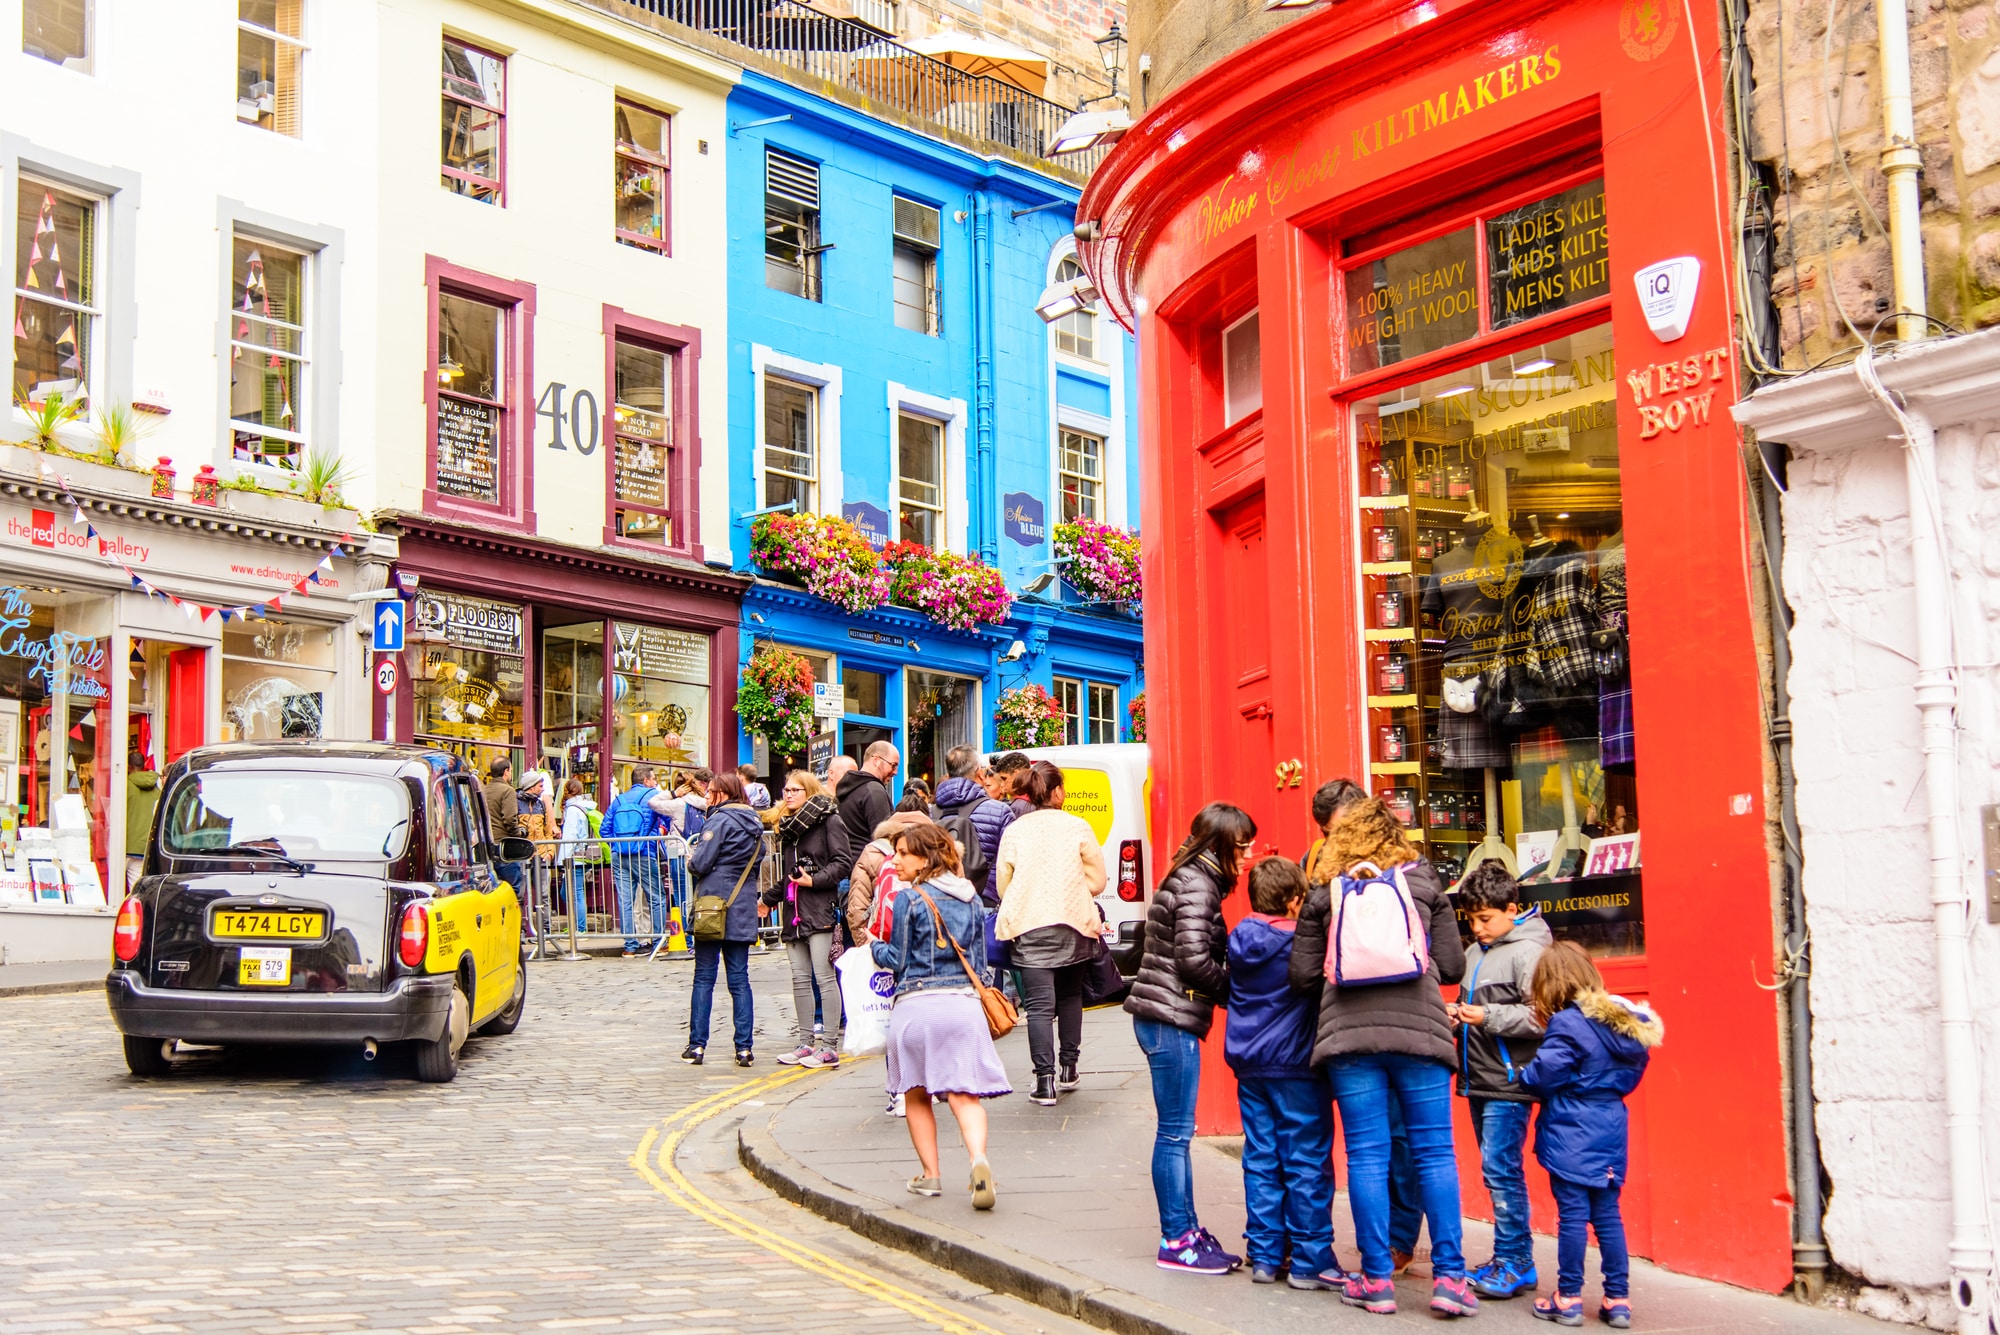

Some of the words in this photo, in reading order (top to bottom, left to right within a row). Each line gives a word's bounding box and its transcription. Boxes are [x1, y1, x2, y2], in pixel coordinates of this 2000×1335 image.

[1196, 174, 1258, 247] Victor
[1266, 141, 1341, 216] Scott
[1351, 45, 1562, 162] KILTMAKERS
[1498, 208, 1565, 253] LADIES
[1570, 193, 1606, 228] KILT
[1511, 244, 1555, 280] KIDS
[1561, 224, 1609, 263] KILTS
[1357, 283, 1404, 318] 100%
[1408, 260, 1466, 300] HEAVY
[1506, 274, 1564, 314] MENS
[1570, 257, 1609, 294] KILT
[1650, 273, 1670, 298] iQ
[1348, 307, 1417, 349] WEIGHT
[1422, 287, 1479, 325] WOOL
[1626, 347, 1728, 406] WEST
[443, 400, 460, 412] WE
[463, 407, 487, 419] HOPE
[536, 381, 599, 456] 40
[1638, 387, 1716, 439] BOW
[444, 421, 459, 429] with
[473, 419, 494, 429] chosen
[622, 425, 652, 436] AFRAID
[630, 417, 647, 427] NOT
[650, 422, 661, 430] BE
[1362, 401, 1437, 450] MADE
[1444, 393, 1471, 428] IN
[439, 428, 475, 441] intelligence
[477, 436, 490, 445] that
[455, 441, 473, 450] spark
[1388, 444, 1449, 481] MADE
[1455, 433, 1486, 465] TO
[1492, 400, 1606, 455] MEASURE
[438, 471, 471, 482] Aesthetic
[472, 479, 491, 487] which
[450, 482, 472, 491] appeal
[8, 517, 31, 538] the
[33, 523, 54, 542] red
[57, 526, 92, 548] door
[99, 536, 149, 562] allery
[1020, 521, 1045, 539] BLEUE
[0, 586, 34, 617] The
[448, 603, 514, 631] FLOORS!
[1440, 598, 1504, 640] Victor
[1513, 595, 1569, 632] Scott
[448, 626, 467, 636] Please
[468, 628, 482, 637] make
[483, 631, 495, 639] free
[643, 635, 667, 644] Replica
[849, 630, 874, 639] RESTAURANT
[1472, 630, 1533, 651] KILTMAKERS
[0, 614, 46, 679] Crag
[427, 651, 441, 668] 40
[500, 659, 522, 670] HOUSE
[1441, 656, 1504, 680] ESTABLISHED
[1506, 655, 1515, 667] IN
[1517, 646, 1569, 666] SCOTLAND
[380, 670, 395, 684] 20
[1276, 759, 1302, 788] 92
[1064, 791, 1098, 799] anches
[1063, 804, 1107, 815] roughout
[1555, 893, 1630, 912] ACCESORIES
[224, 916, 271, 933] T474
[277, 917, 314, 933] LGY
[265, 961, 283, 971] 579
